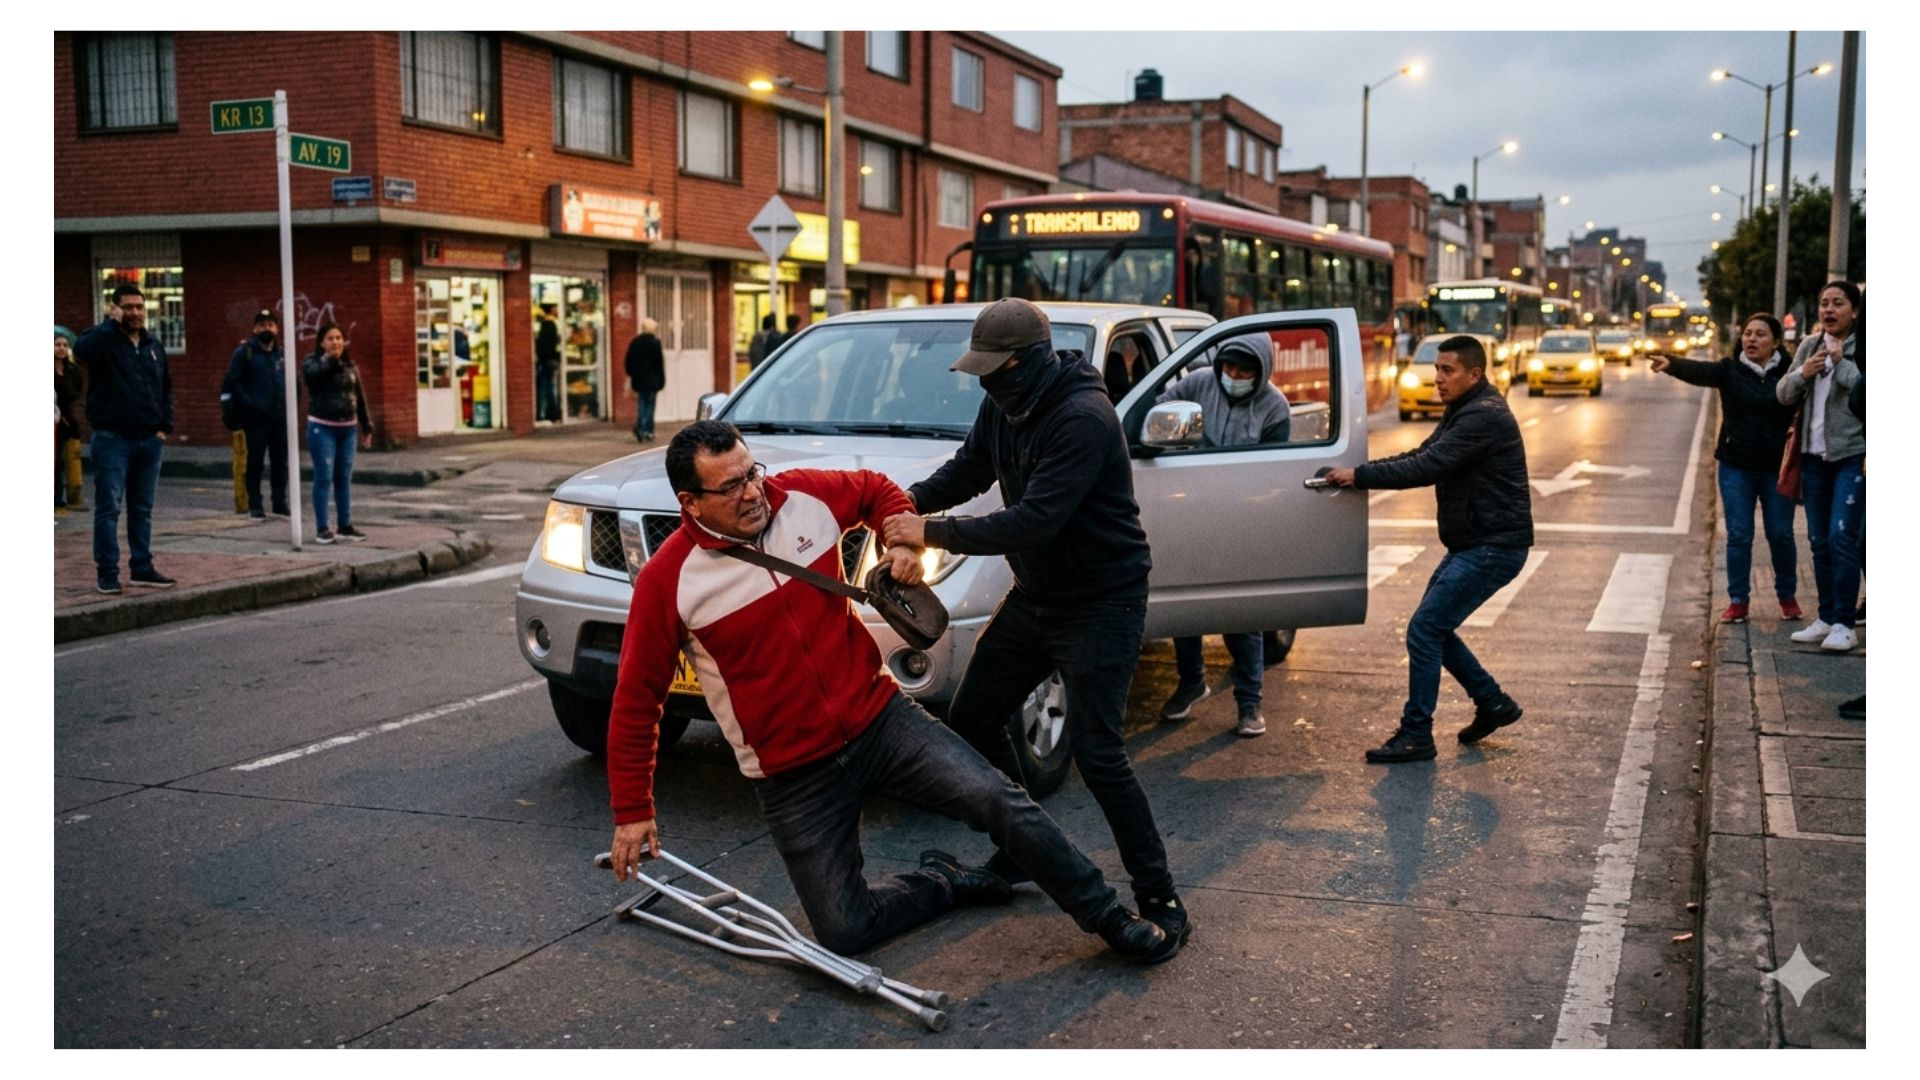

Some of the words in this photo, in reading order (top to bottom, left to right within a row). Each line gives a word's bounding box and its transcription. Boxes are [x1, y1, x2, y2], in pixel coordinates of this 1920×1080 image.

[220, 107, 241, 128] KR
[249, 105, 264, 126] 13
[298, 142, 321, 163] AV.
[326, 145, 342, 166] 19
